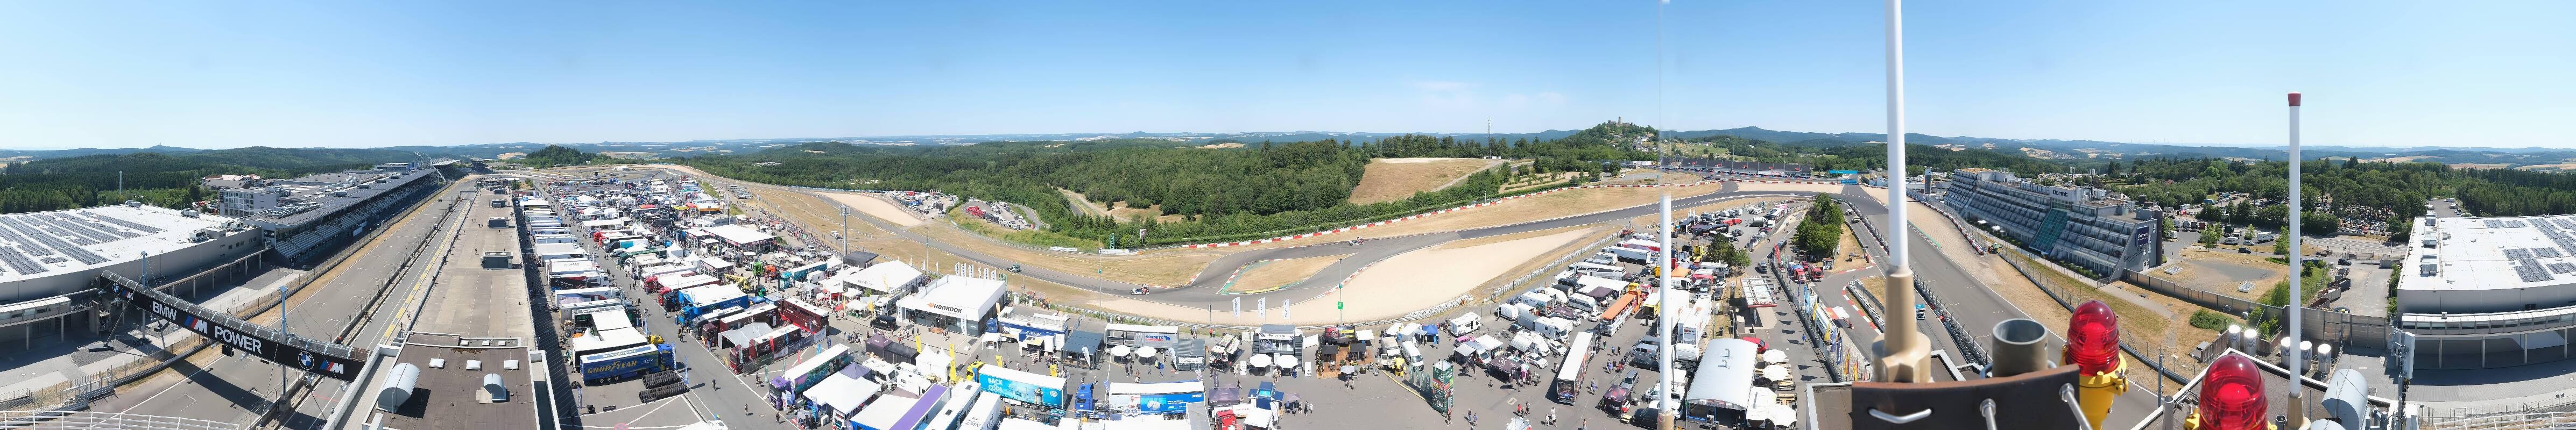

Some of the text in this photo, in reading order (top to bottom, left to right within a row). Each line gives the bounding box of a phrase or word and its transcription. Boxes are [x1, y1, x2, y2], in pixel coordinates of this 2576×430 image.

[153, 300, 177, 321] BMW
[215, 325, 262, 354] POWER
[587, 360, 637, 374] GOODYEAR
